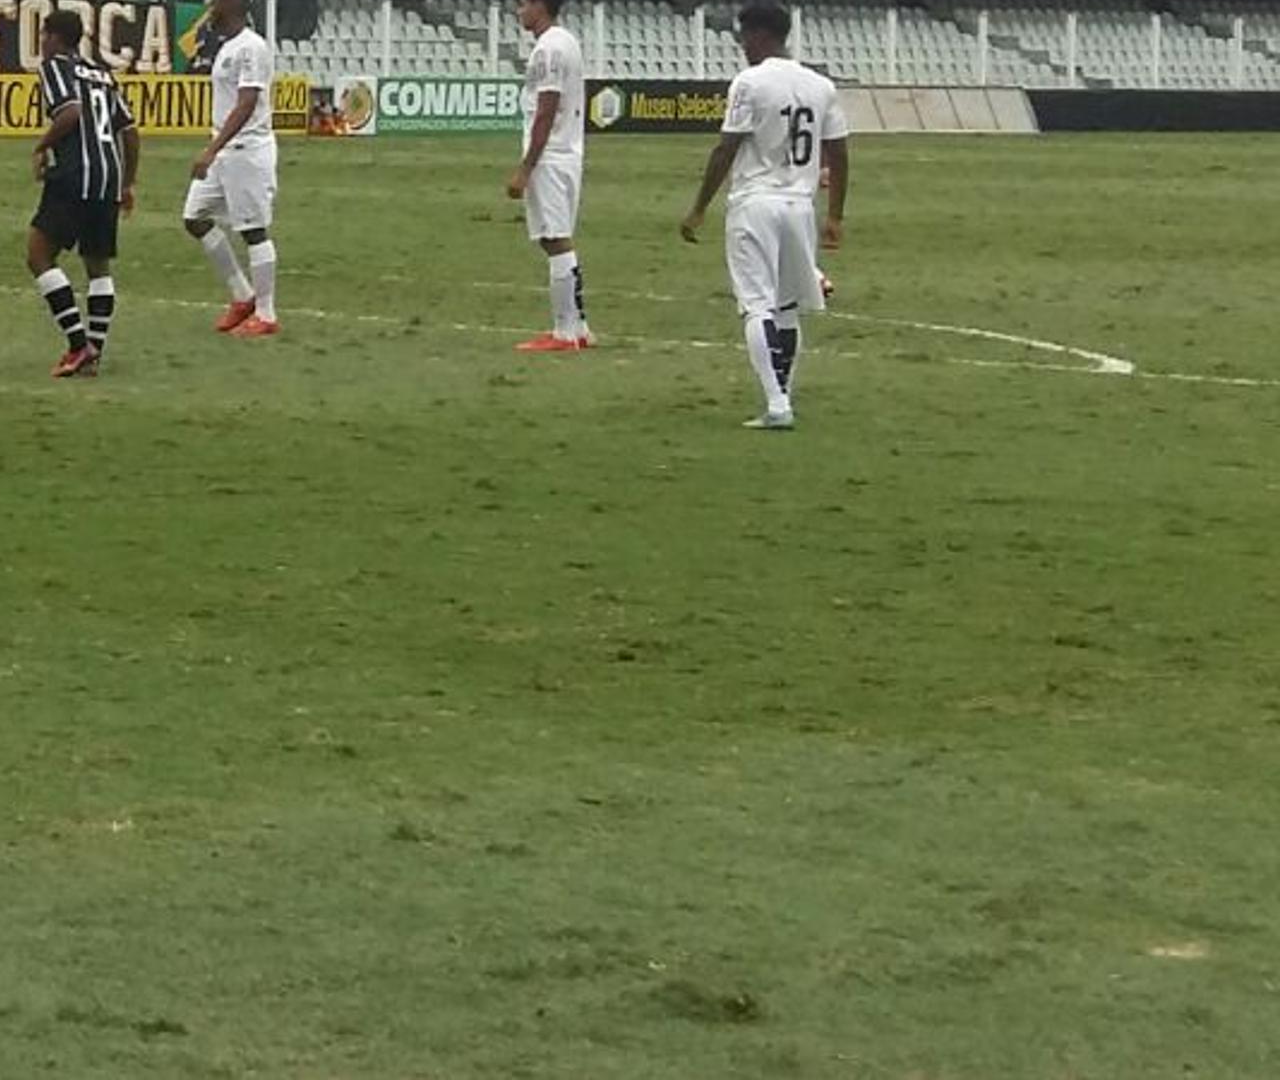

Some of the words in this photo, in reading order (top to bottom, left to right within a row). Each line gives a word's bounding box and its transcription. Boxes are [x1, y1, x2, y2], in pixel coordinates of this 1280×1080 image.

[90, 88, 113, 143] 2
[631, 92, 675, 119] Museu
[780, 104, 815, 167] 16
